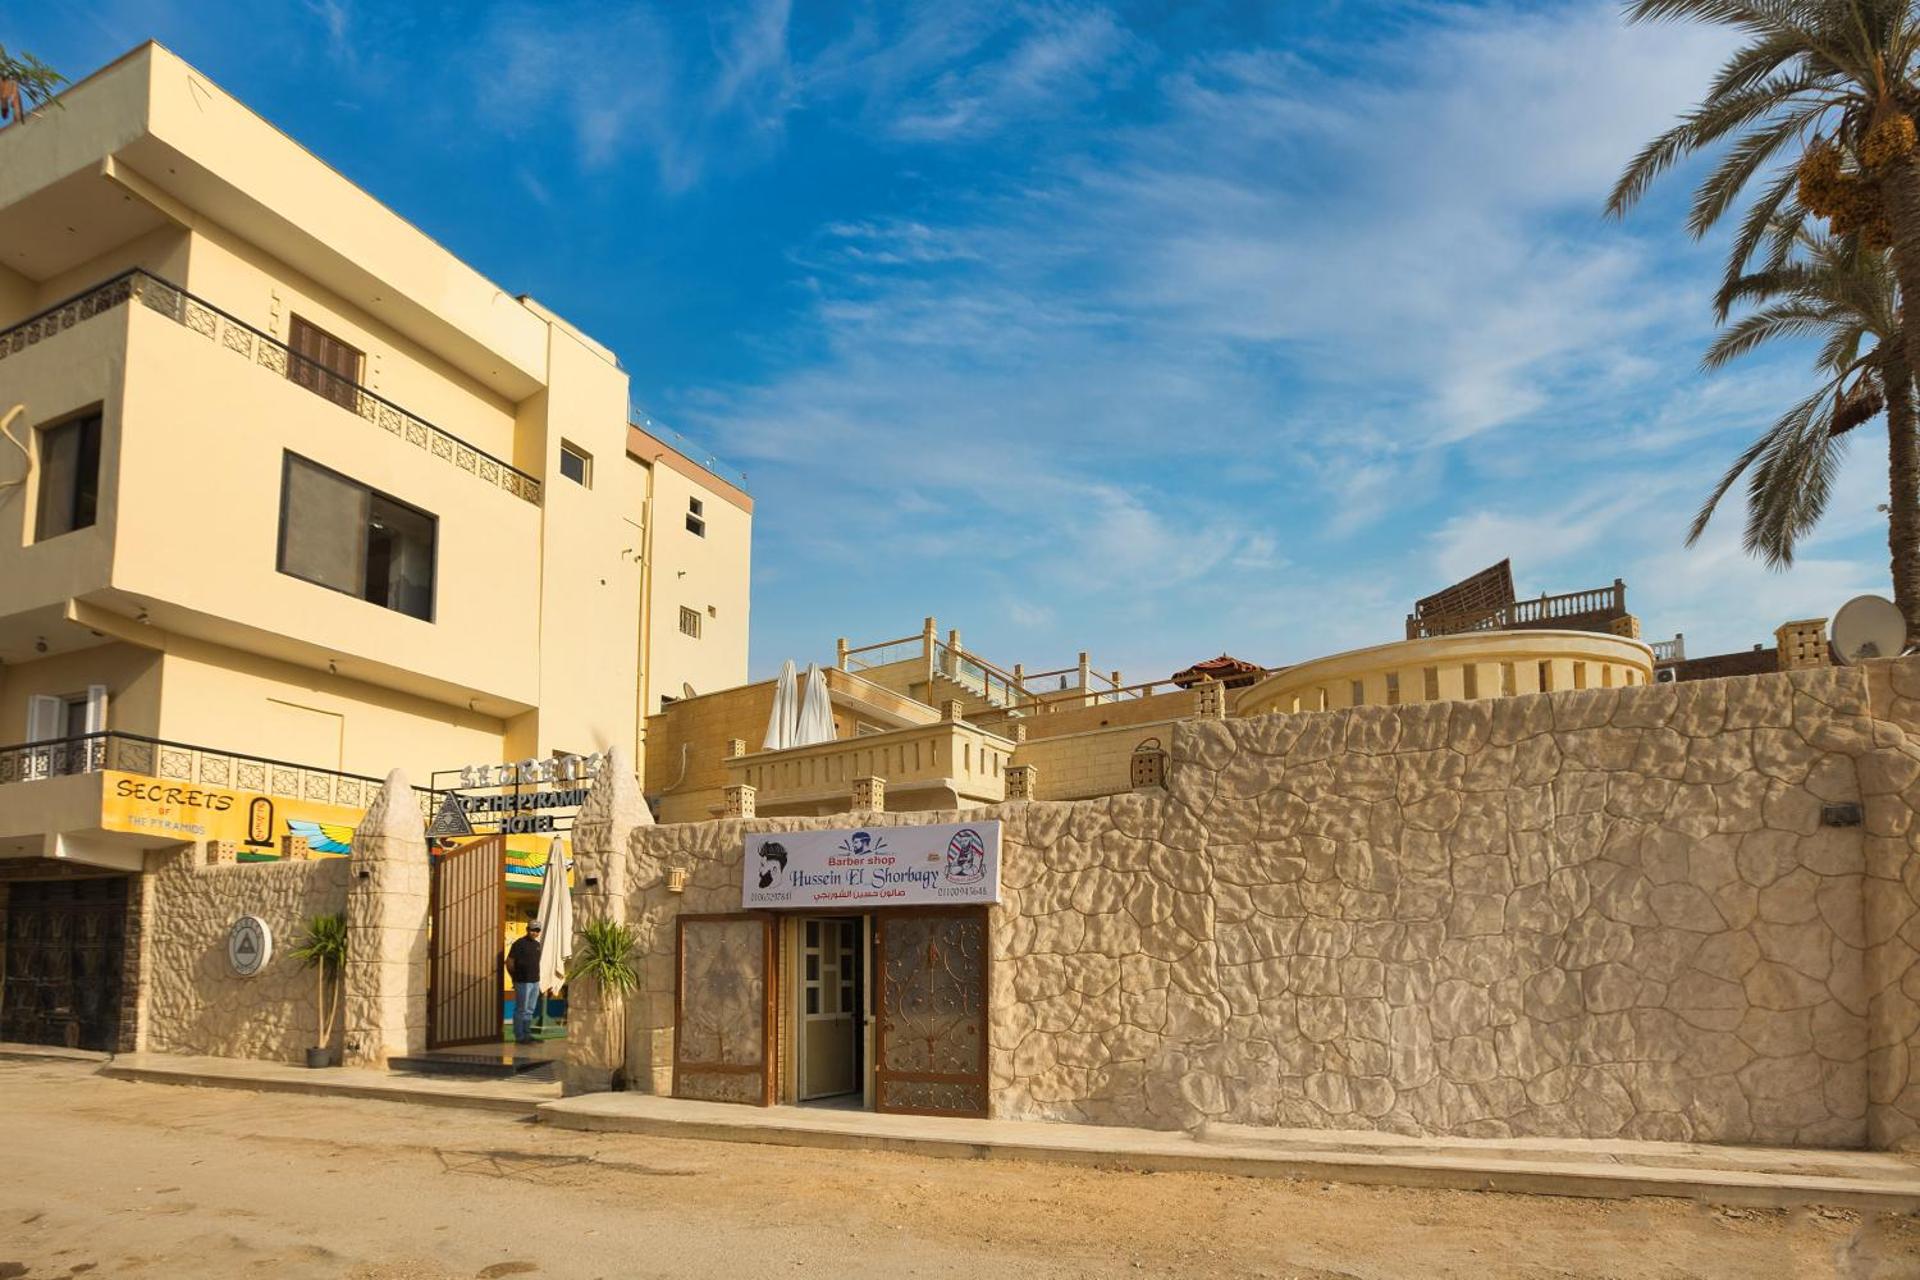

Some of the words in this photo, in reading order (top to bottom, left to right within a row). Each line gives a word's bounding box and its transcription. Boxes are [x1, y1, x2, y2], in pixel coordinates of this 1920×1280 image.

[459, 752, 605, 788] SECRETS
[117, 780, 234, 810] SECRETS
[461, 797, 486, 814] OF
[486, 793, 516, 812] THE
[158, 808, 171, 816] OF
[128, 815, 147, 827] THE
[150, 818, 206, 836] PYRAMIDS
[500, 815, 555, 834] HOTEL
[828, 857, 865, 866] Barber
[867, 856, 895, 866] shop
[790, 870, 840, 887] Hussein
[846, 868, 863, 886] El
[872, 868, 939, 889] Shorbagy
[853, 891, 879, 899] حسين
